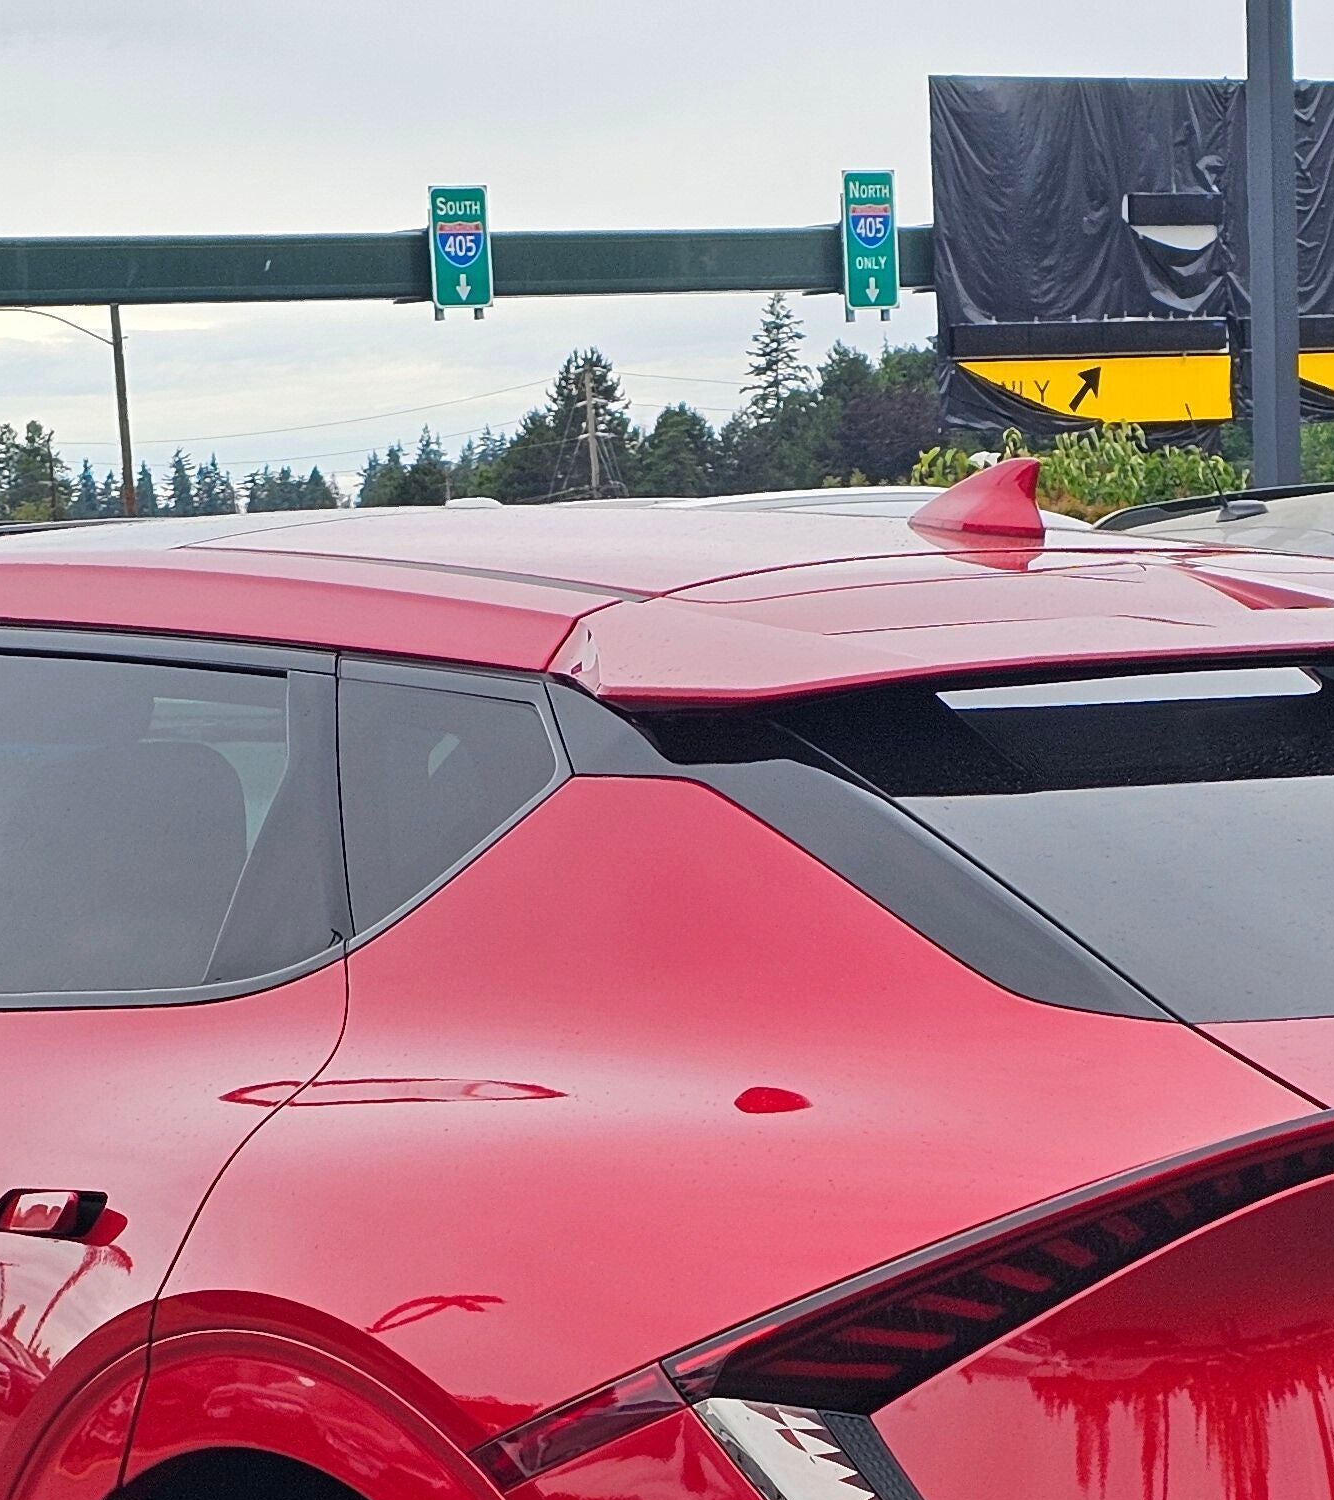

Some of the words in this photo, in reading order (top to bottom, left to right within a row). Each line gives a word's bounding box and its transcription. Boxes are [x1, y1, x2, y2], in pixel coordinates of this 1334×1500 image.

[849, 180, 890, 199] NORTH
[436, 197, 481, 216] SOUTH
[856, 217, 885, 238] 405
[444, 235, 477, 257] 405
[855, 256, 887, 270] ONLY
